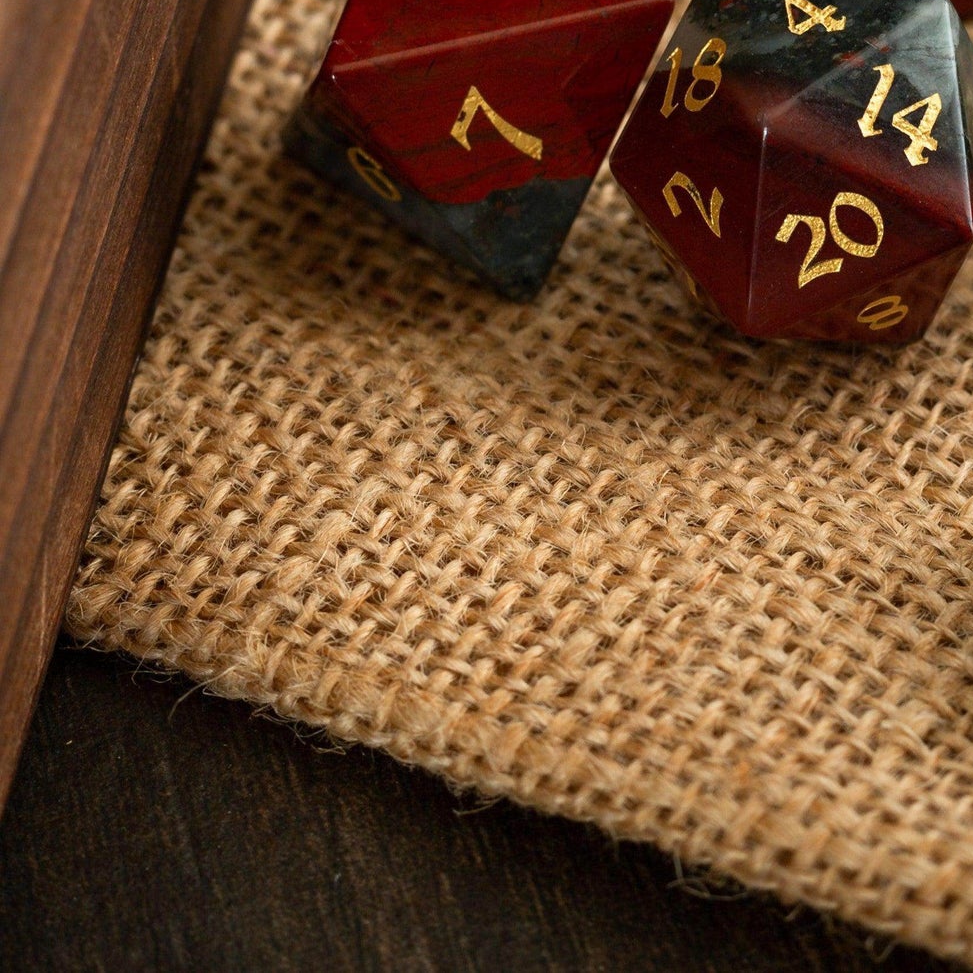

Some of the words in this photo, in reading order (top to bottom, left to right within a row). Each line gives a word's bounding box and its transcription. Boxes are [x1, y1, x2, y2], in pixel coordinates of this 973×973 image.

[659, 37, 728, 118] 18
[856, 63, 942, 166] 14
[450, 85, 543, 160] 7
[662, 171, 724, 238] 2
[775, 191, 885, 289] 20
[856, 295, 909, 330] 8
